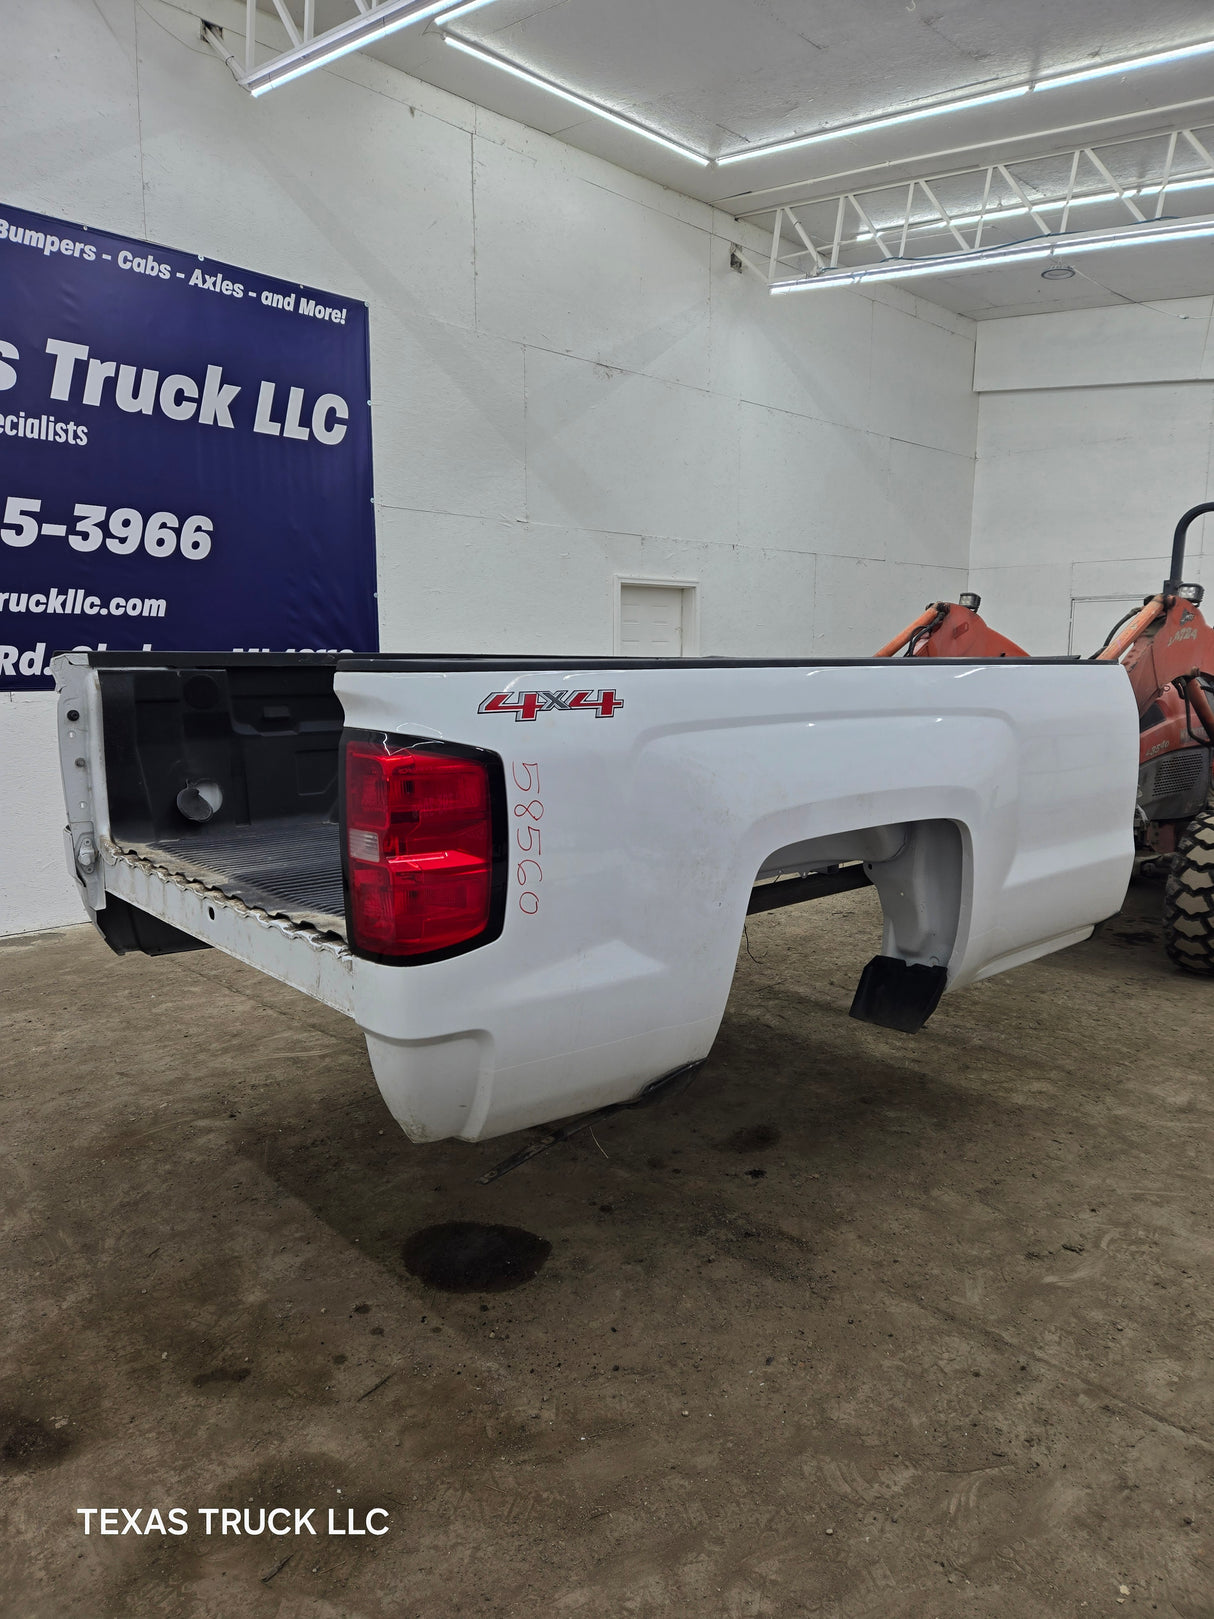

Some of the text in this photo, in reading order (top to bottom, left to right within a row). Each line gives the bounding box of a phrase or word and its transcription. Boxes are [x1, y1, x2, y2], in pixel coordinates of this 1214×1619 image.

[0, 218, 96, 261] Bumpers
[118, 251, 171, 279] Cabs
[189, 269, 244, 298] Axles
[261, 288, 295, 312] and
[299, 298, 347, 325] More!
[46, 338, 242, 429] Truck
[253, 380, 349, 445] LLC
[0, 496, 214, 560] 5-3966
[512, 761, 544, 914] 58560
